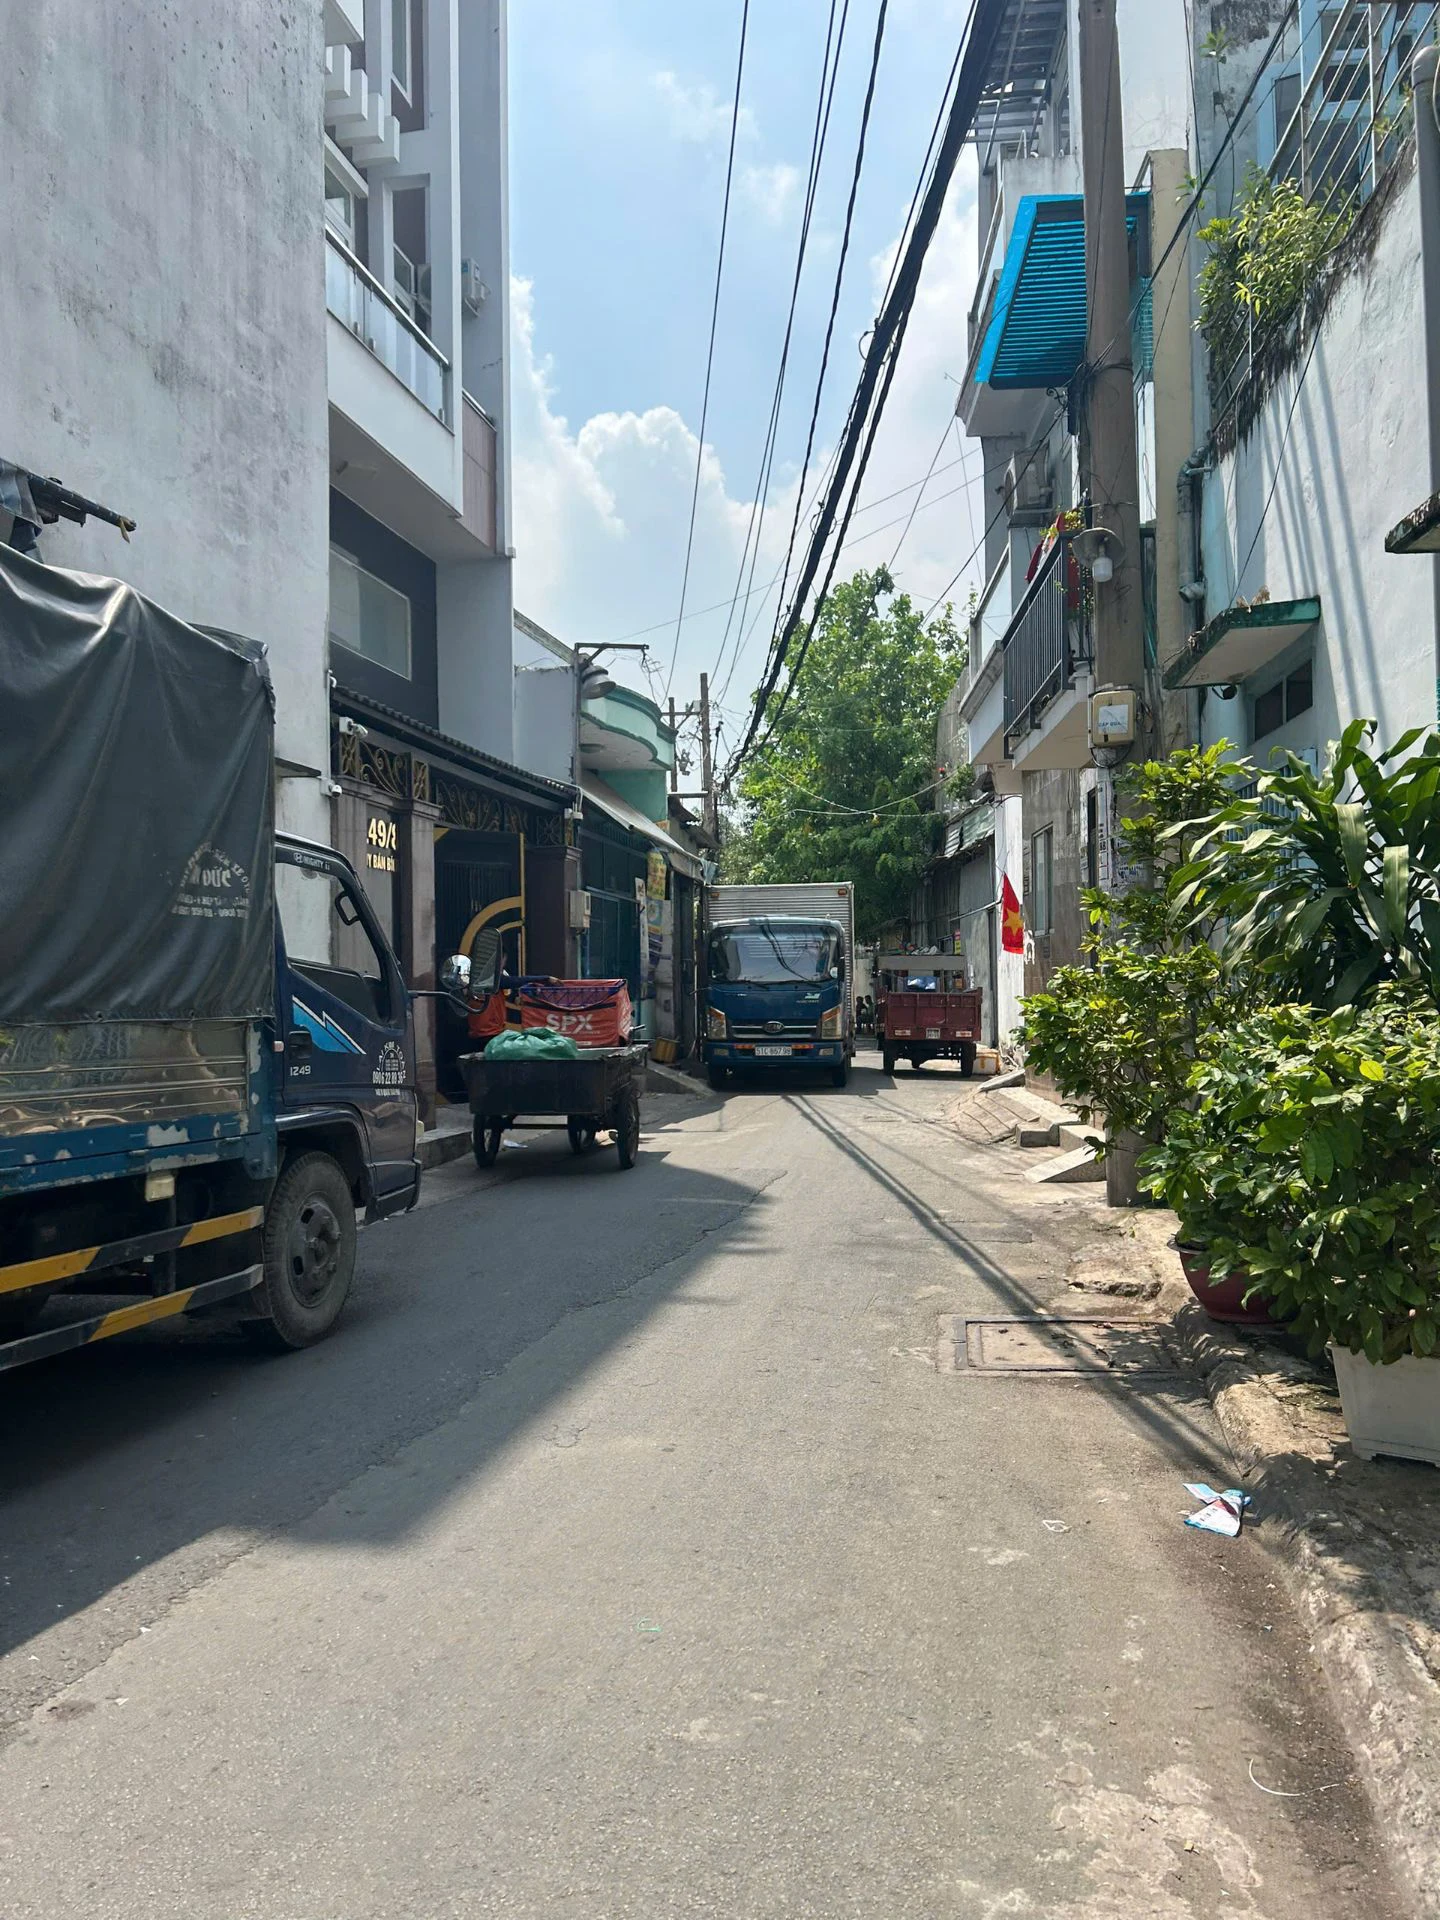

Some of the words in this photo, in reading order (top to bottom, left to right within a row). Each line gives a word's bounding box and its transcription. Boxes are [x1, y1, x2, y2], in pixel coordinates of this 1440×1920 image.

[372, 852, 386, 870] BÁN
[546, 1014, 593, 1034] SPX
[290, 1065, 311, 1076] 1249
